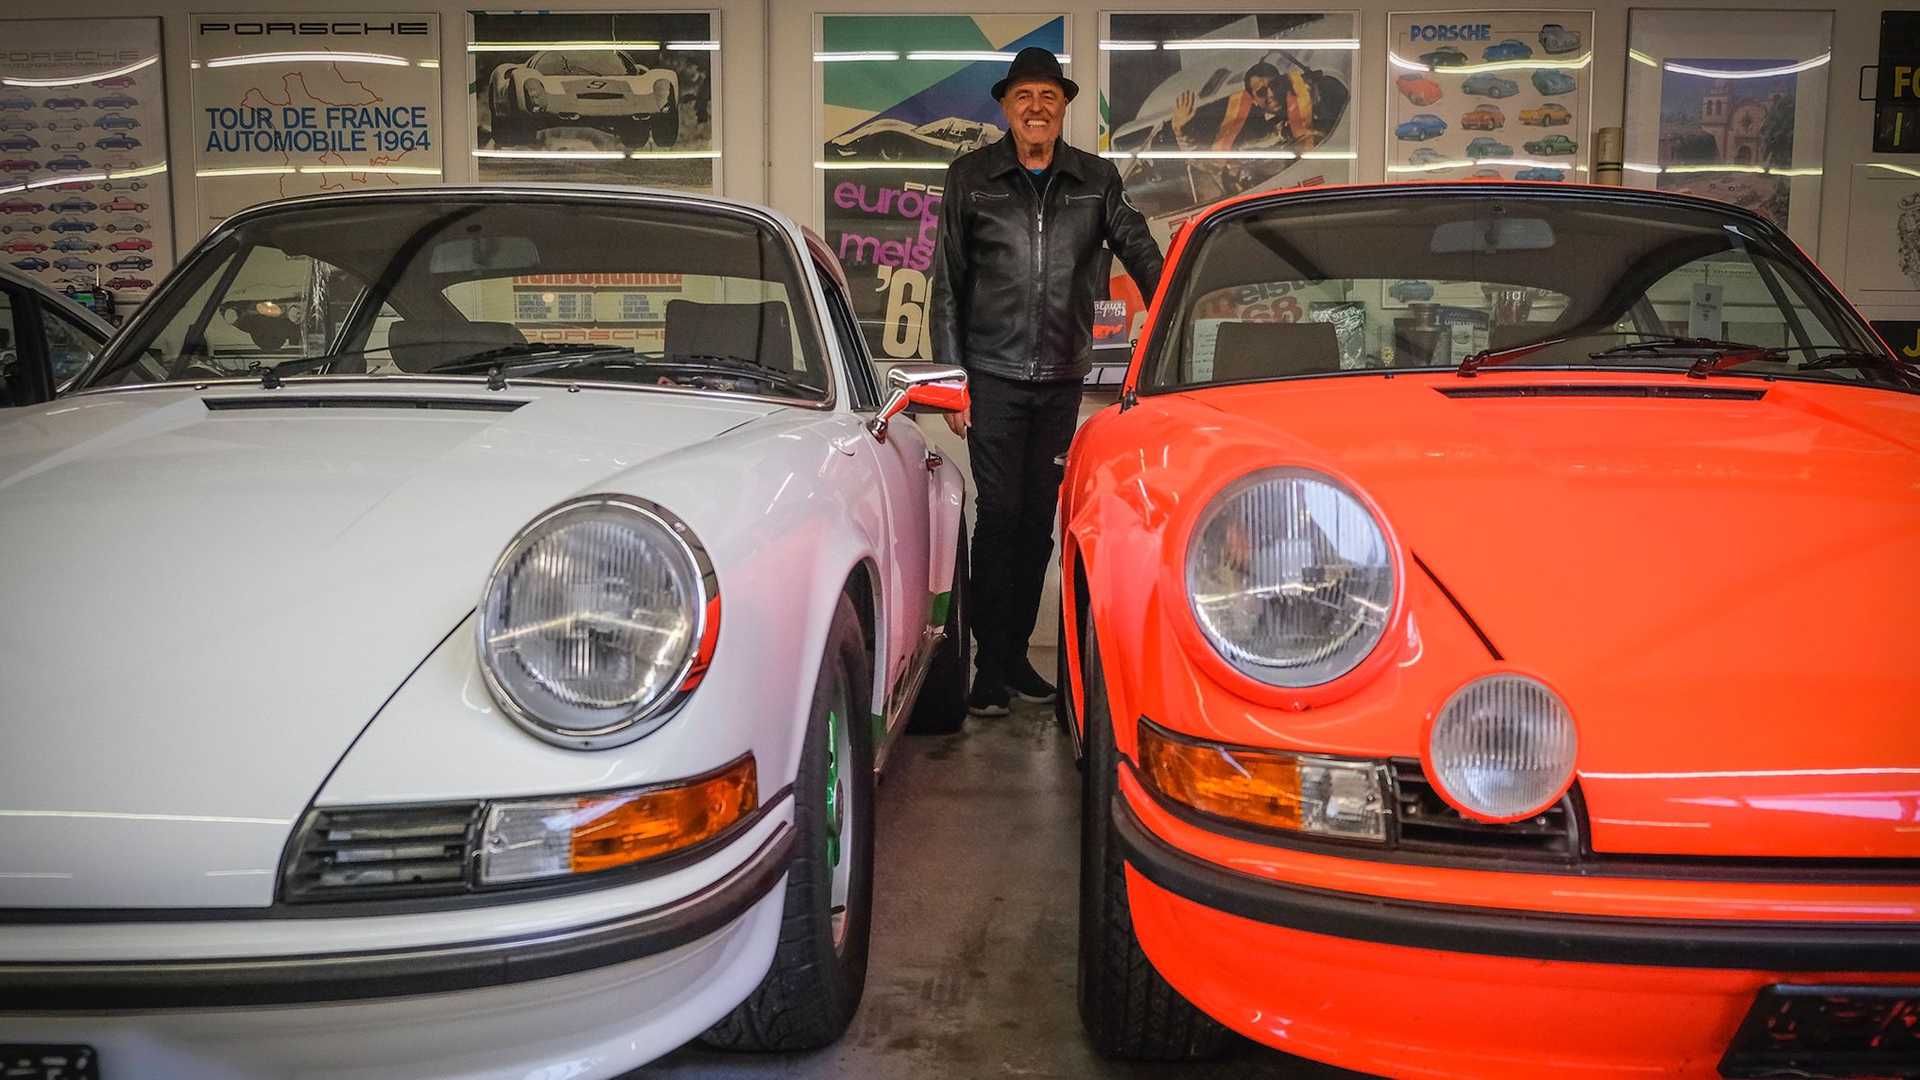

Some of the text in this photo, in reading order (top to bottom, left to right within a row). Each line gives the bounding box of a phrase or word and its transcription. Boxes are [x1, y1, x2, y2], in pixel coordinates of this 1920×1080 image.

[200, 22, 428, 35] PORSCHE
[1410, 24, 1491, 42] PORSCHE
[206, 106, 428, 130] TOUR DE FRANCE
[206, 130, 431, 153] AUTOMOBILE 1964
